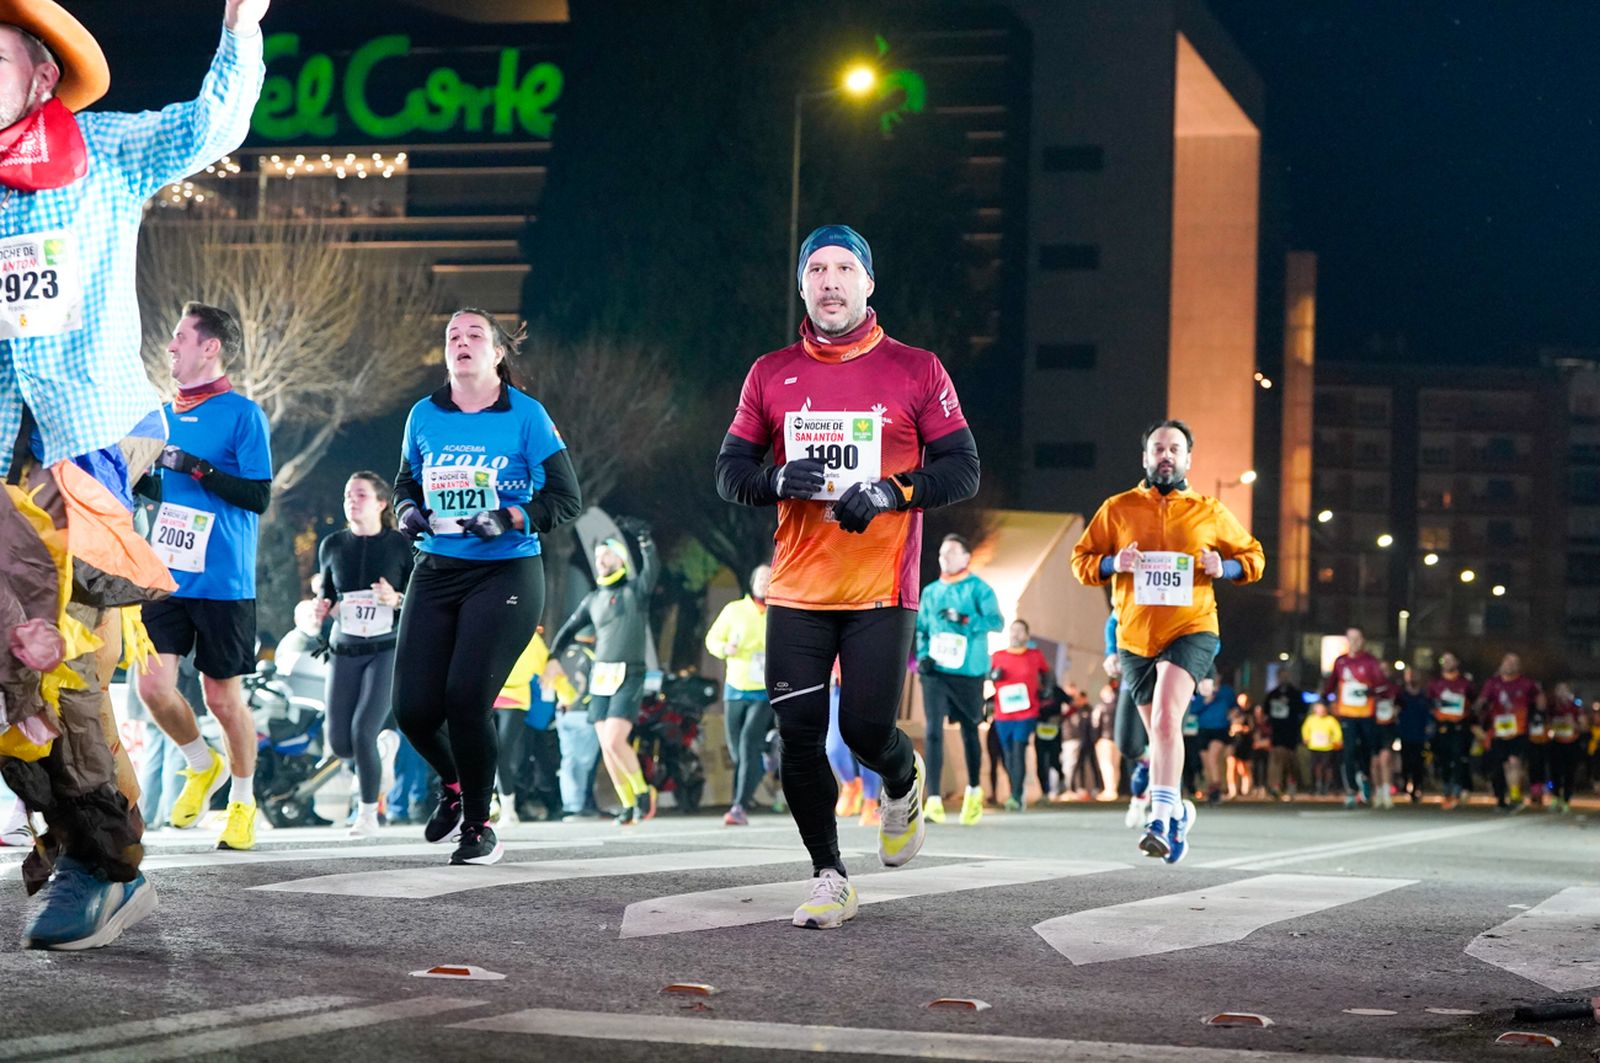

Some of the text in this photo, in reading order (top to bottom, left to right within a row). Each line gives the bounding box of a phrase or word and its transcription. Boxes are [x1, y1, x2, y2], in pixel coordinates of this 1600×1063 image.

[343, 33, 564, 138] Corte
[0, 269, 59, 303] 923
[804, 422, 844, 431] NOCHE DE
[795, 432, 813, 442] SAN
[813, 430, 844, 442] ANTÓN
[442, 444, 486, 453] ACADEMIA
[805, 444, 859, 470] 1190
[431, 482, 446, 490] SAN
[437, 488, 486, 511] 12121
[158, 525, 196, 550] 2003
[1145, 571, 1181, 587] 7095
[356, 605, 376, 620] 377
